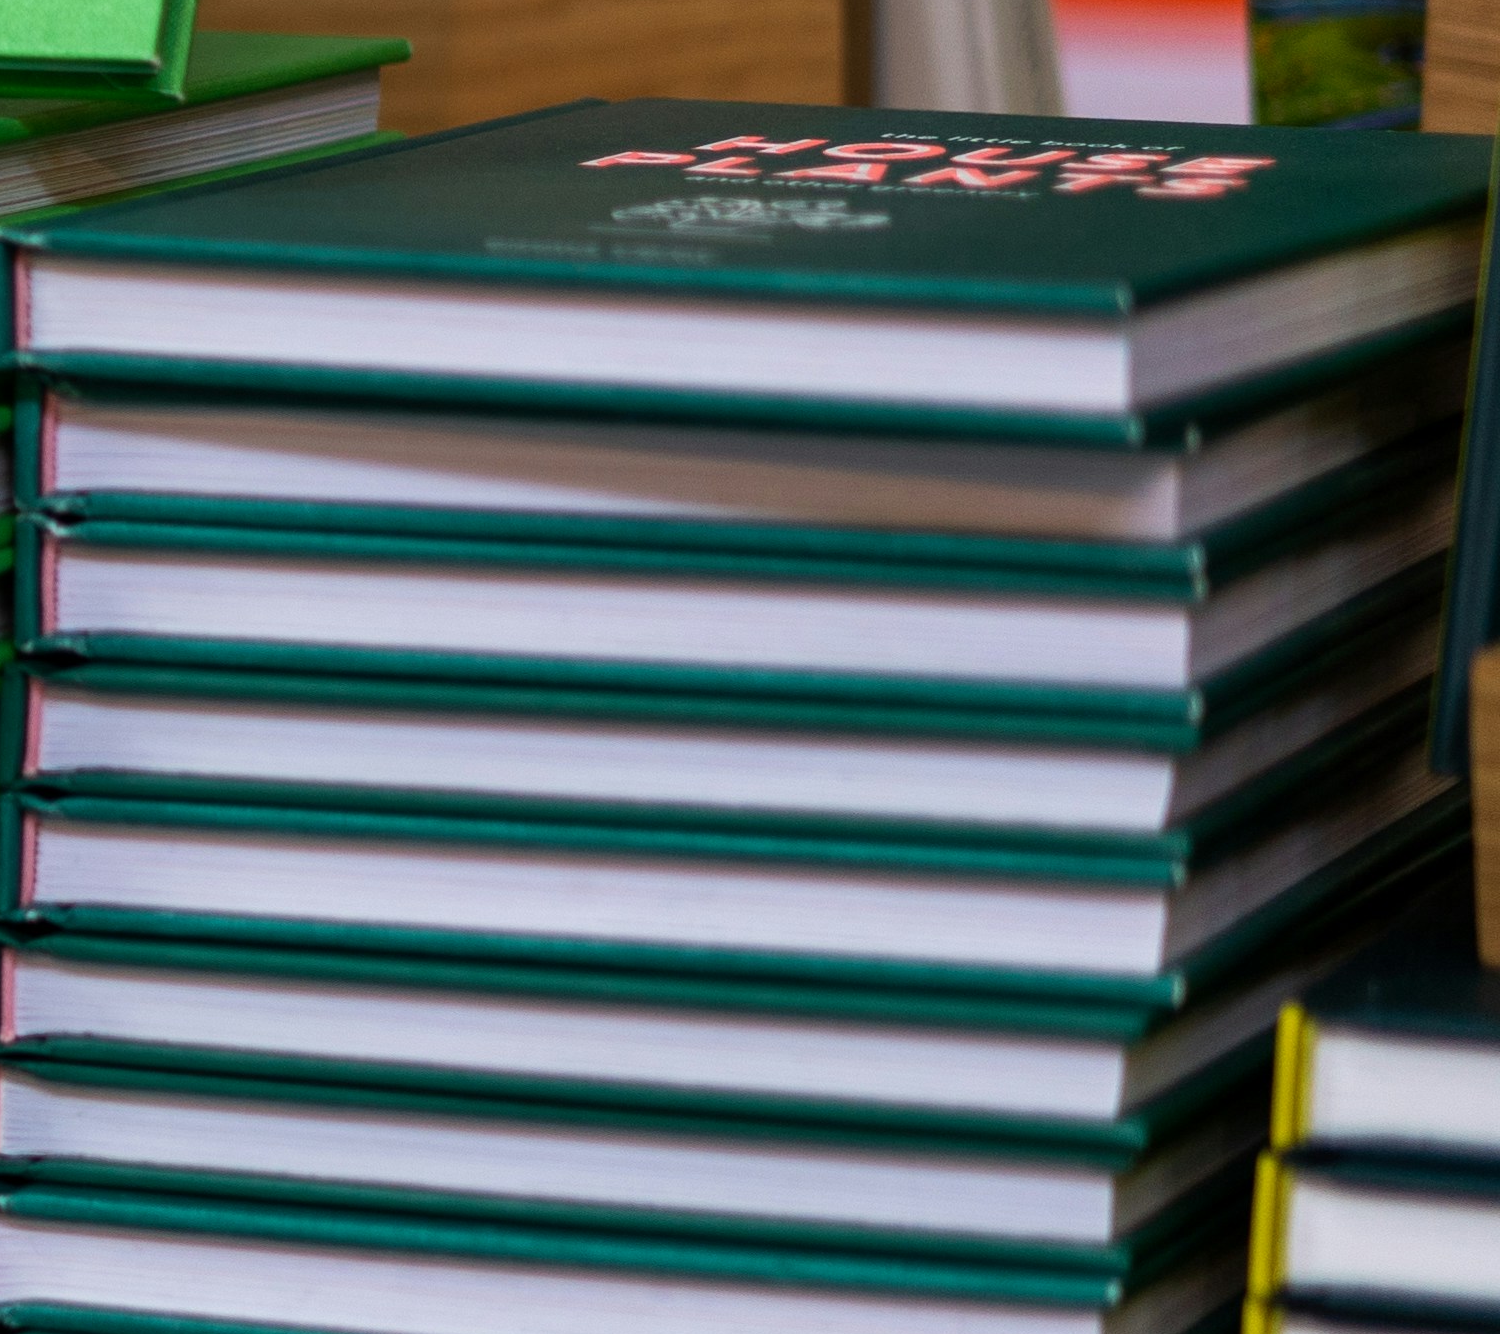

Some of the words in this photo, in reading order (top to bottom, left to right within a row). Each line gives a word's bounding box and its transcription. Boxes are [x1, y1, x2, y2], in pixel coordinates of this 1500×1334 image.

[693, 134, 1278, 176] HOUSE
[879, 131, 939, 142] the
[947, 134, 1032, 146] little
[1039, 138, 1130, 151] book
[577, 150, 1250, 200] PLANTS
